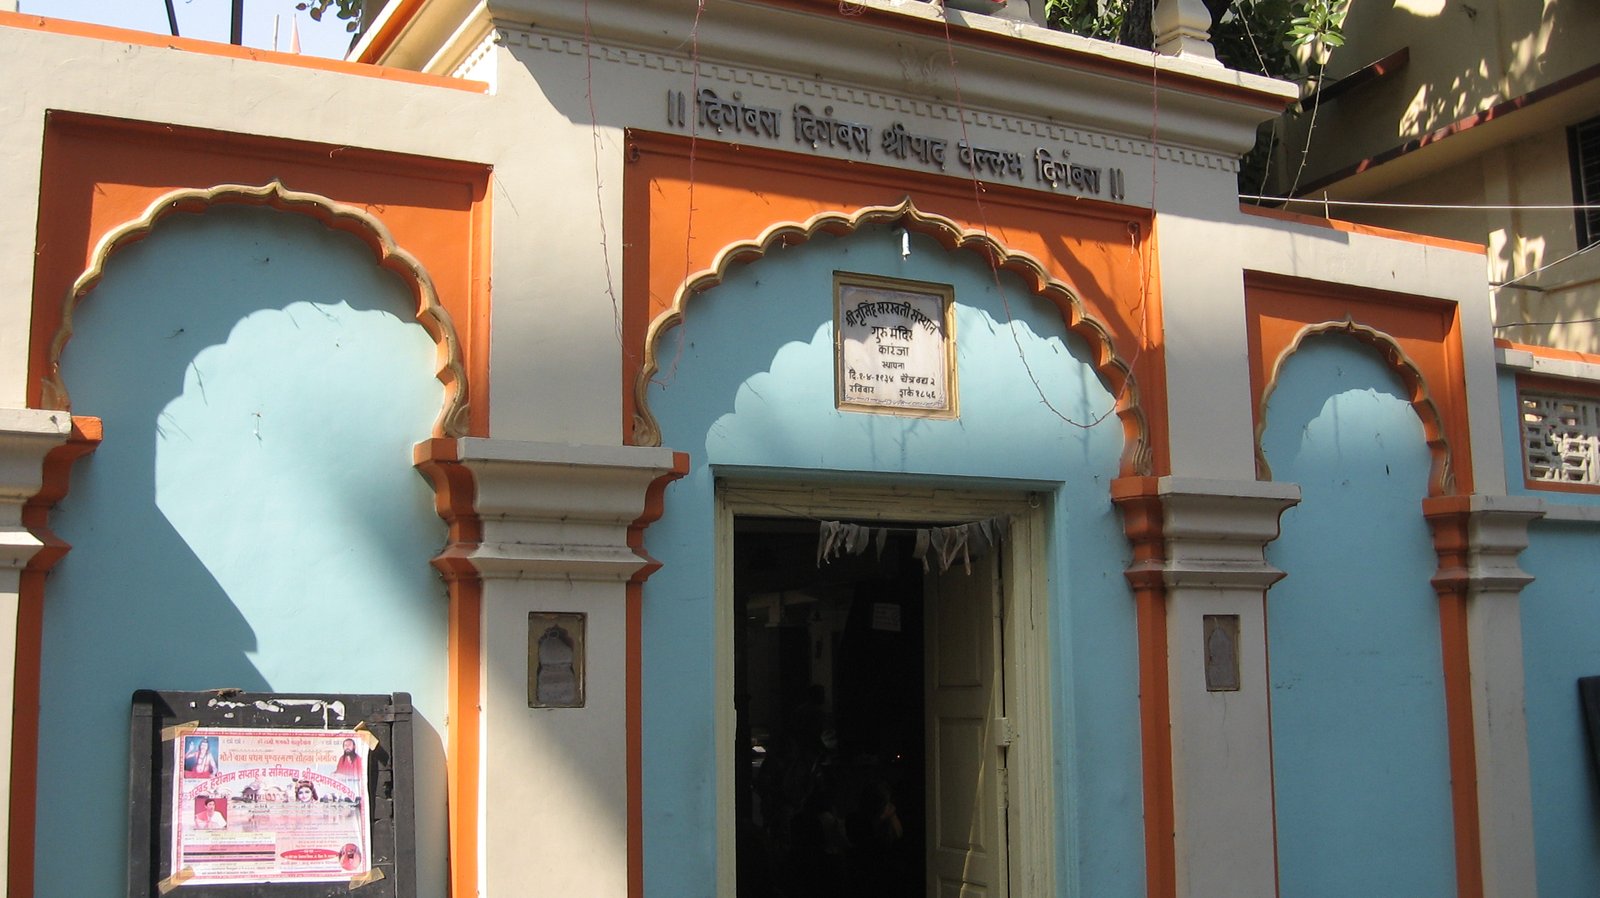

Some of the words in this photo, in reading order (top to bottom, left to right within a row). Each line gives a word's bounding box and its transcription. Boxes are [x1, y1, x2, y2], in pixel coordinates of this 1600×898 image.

[881, 121, 948, 171] श्रीपाद
[957, 138, 1026, 180] वल्लभ
[910, 308, 938, 335] संस्थान
[871, 326, 888, 344] गुरु
[889, 325, 913, 342] मंदिर
[878, 343, 909, 356] कारंजा
[881, 361, 905, 370] स्थापना
[849, 382, 875, 394] रविवार
[899, 386, 914, 398] शके
[238, 768, 260, 780] सप्ताह
